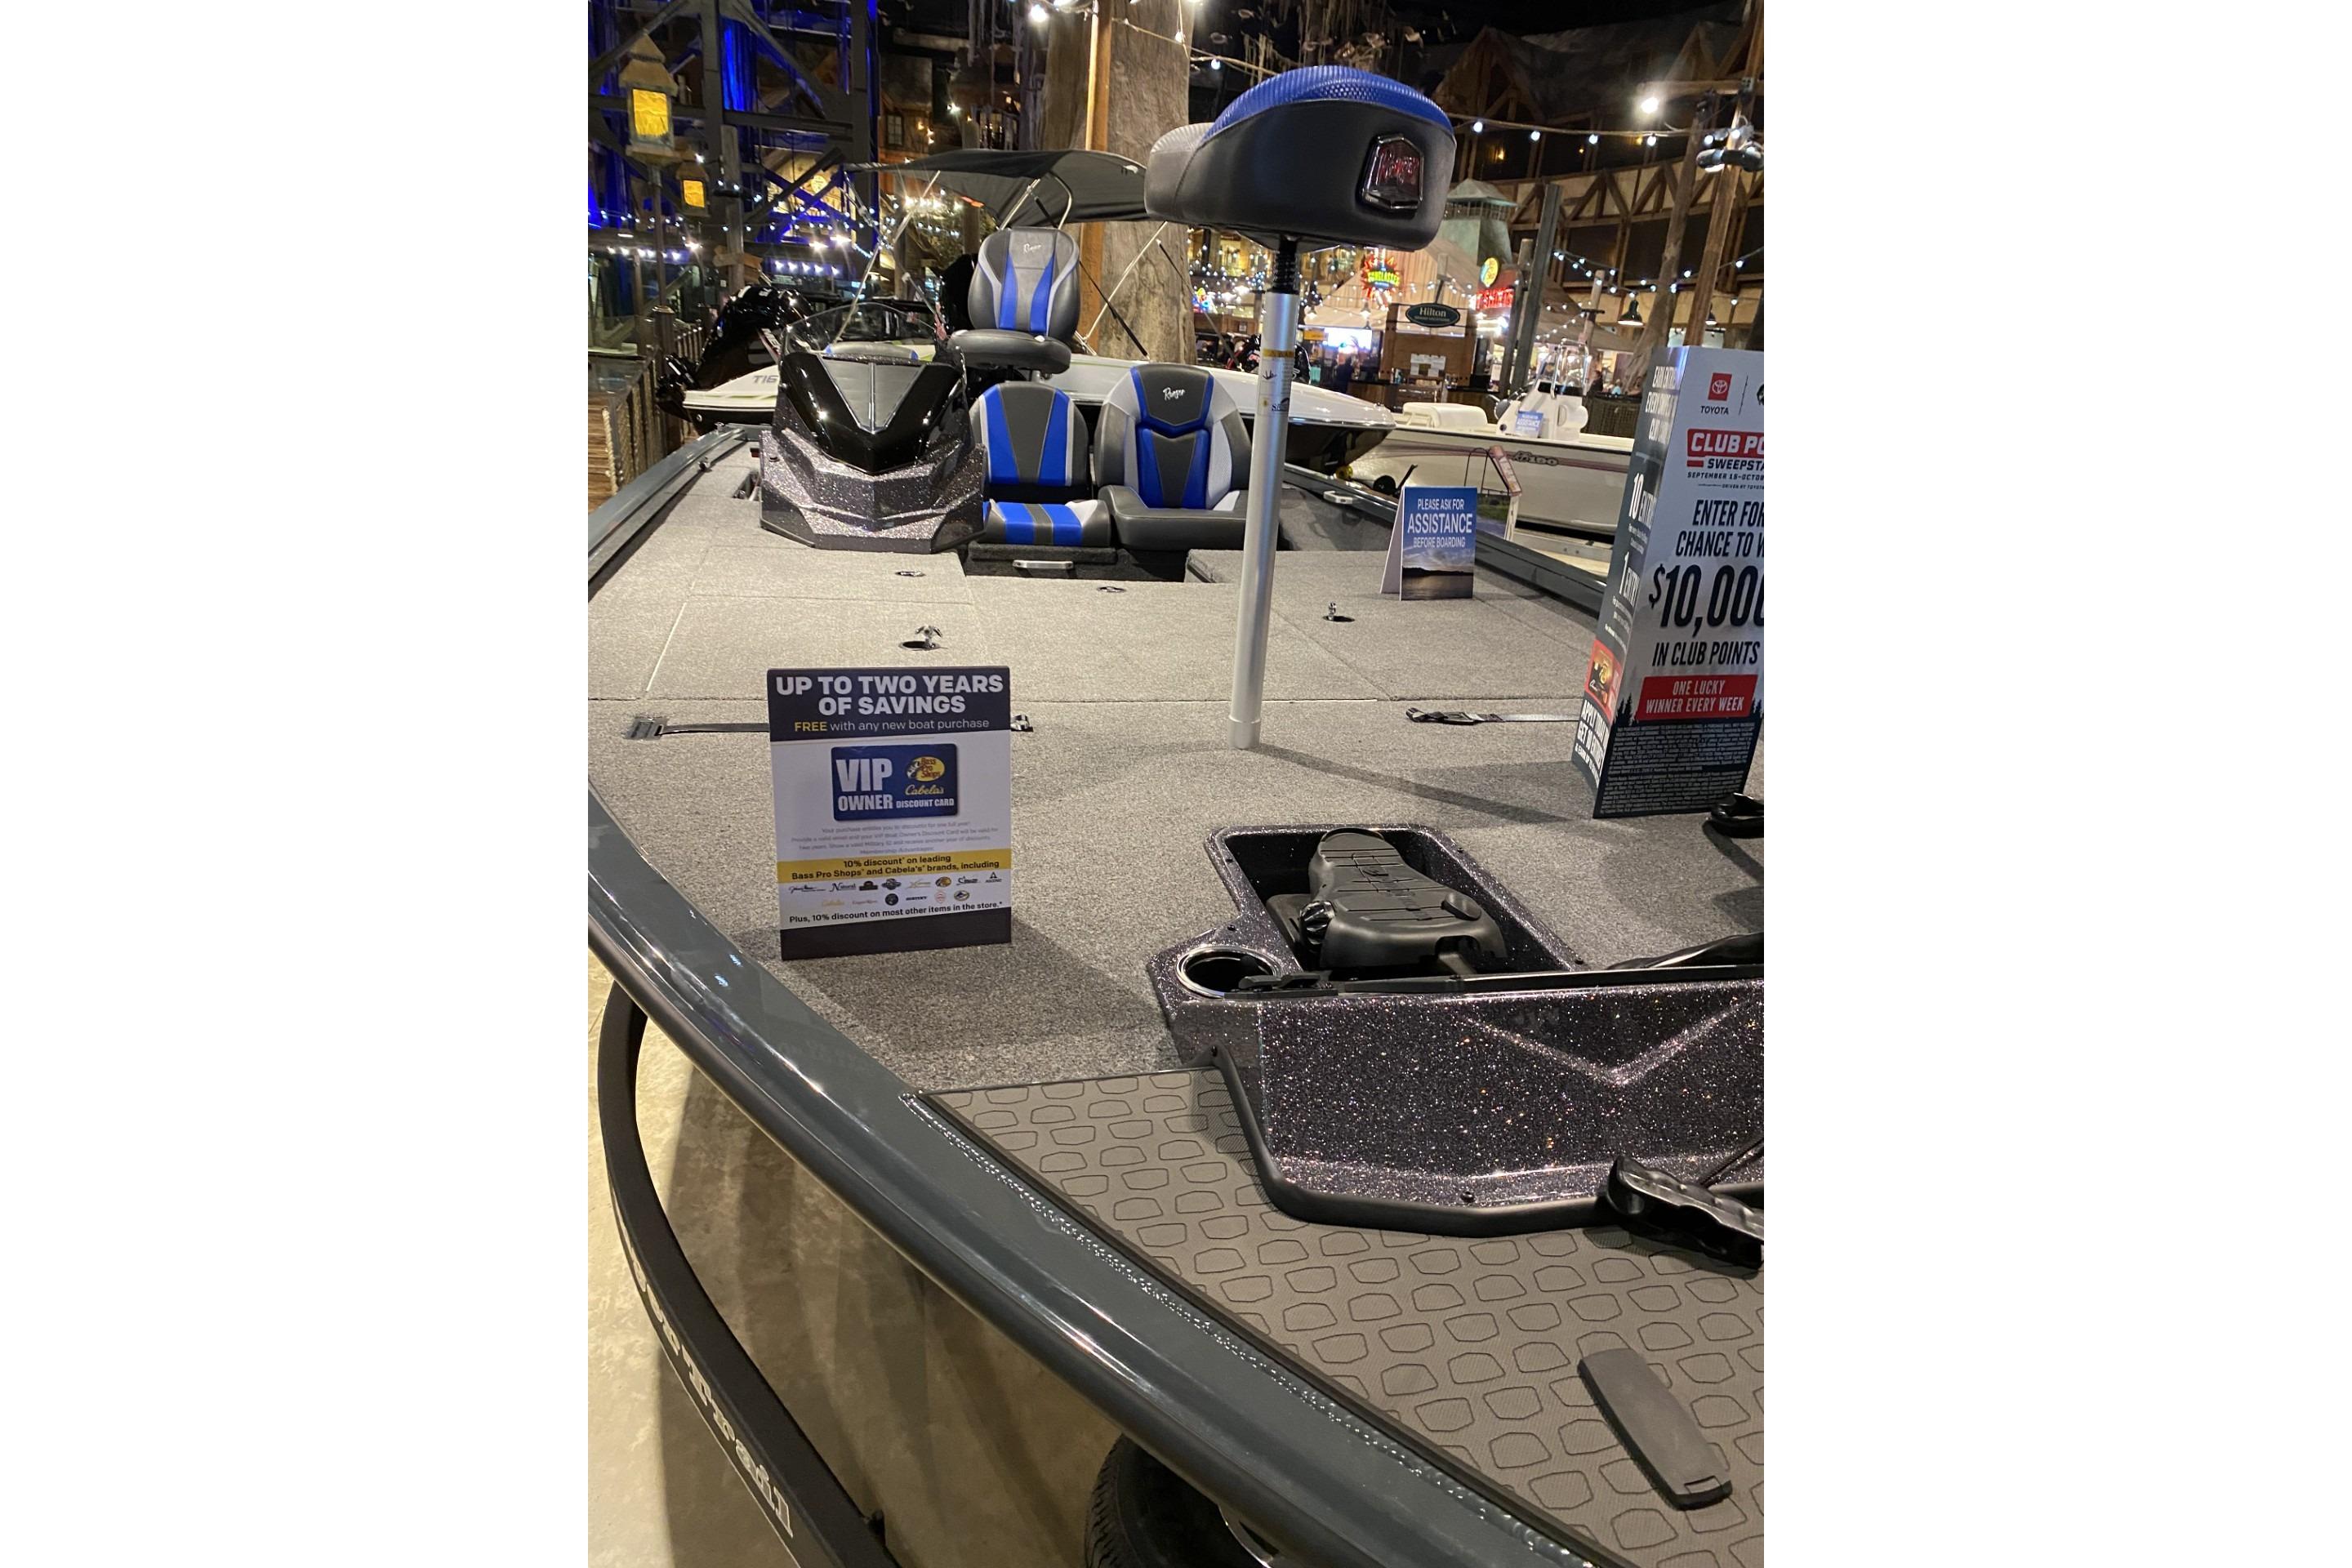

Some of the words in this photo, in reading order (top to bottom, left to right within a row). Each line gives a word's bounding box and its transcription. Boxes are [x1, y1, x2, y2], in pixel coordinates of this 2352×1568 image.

[1419, 307, 1446, 317] Hilton
[1700, 406, 1729, 415] TOYOTA
[1690, 432, 1741, 453] CLUB
[1417, 498, 1440, 510] PLEASE
[1440, 498, 1452, 510] ASK
[1452, 498, 1464, 510] FOR
[1692, 500, 1738, 527] ENTER
[1407, 513, 1472, 533] ASSISTANCE
[1413, 537, 1436, 548] BEFORE
[1437, 537, 1466, 548] BOARDING
[1676, 530, 1734, 557] CHANCE
[1735, 532, 1754, 557] TO
[1652, 642, 1669, 666] IN
[1671, 641, 1708, 665] CLUB
[1709, 641, 1761, 665] POINTS
[776, 676, 813, 695] UP
[817, 675, 853, 694] TO
[858, 675, 916, 694] TWO
[922, 675, 1004, 693] YEARS
[1673, 680, 1692, 695] ONE
[1694, 679, 1726, 695] LUCKY
[818, 697, 852, 715] OF
[858, 695, 966, 715] SAVINGS
[1646, 698, 1684, 714] WINNER
[1685, 697, 1717, 712] EVERY
[1718, 697, 1745, 711] WEEK
[794, 722, 828, 732] FREE
[830, 721, 855, 731] with
[858, 722, 880, 733] any
[882, 721, 906, 729] new
[908, 719, 934, 729] boat
[938, 719, 990, 731] purchase
[835, 758, 893, 792] VIP
[838, 794, 893, 812] OWNER
[896, 799, 933, 808] DISCOUNT
[934, 798, 955, 807] CARD
[844, 859, 862, 868] 10%
[920, 854, 951, 864] leading
[791, 872, 814, 880] Bass
[866, 867, 883, 875] and
[927, 862, 959, 871] brands,
[960, 861, 1000, 870] including
[789, 915, 810, 924] Plus,
[831, 911, 868, 920] discount
[882, 908, 903, 916] most
[905, 906, 927, 915] other
[929, 904, 951, 913] items
